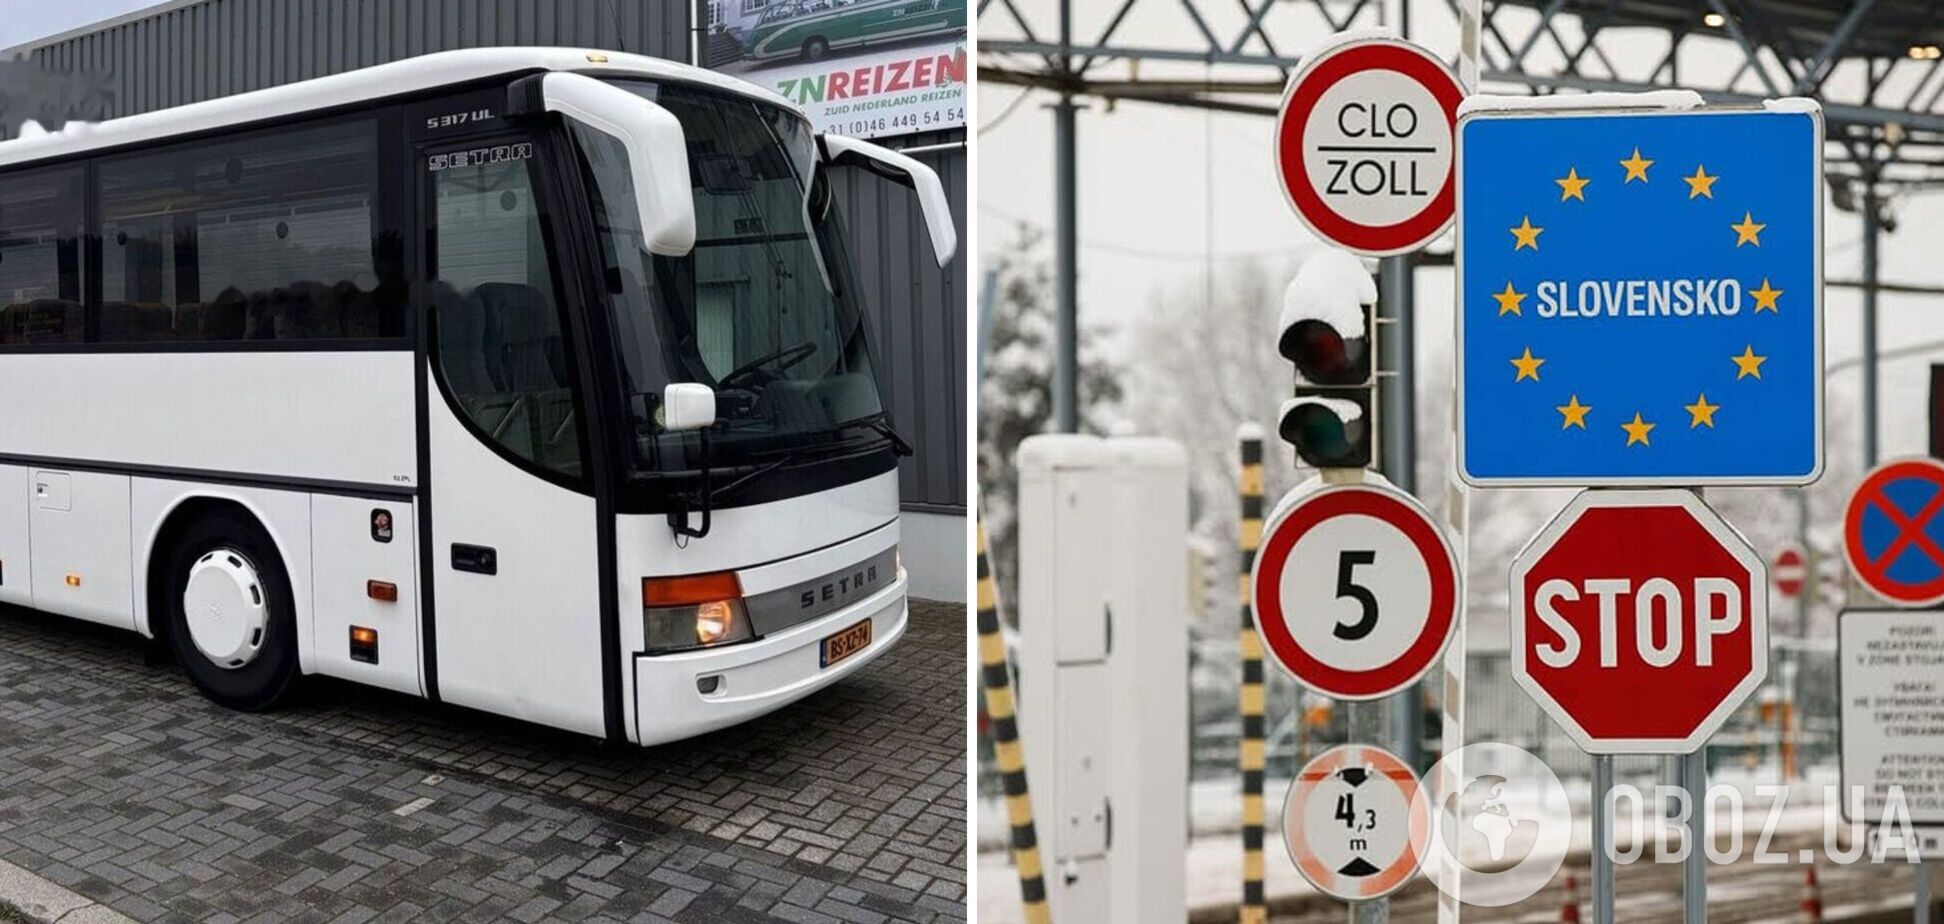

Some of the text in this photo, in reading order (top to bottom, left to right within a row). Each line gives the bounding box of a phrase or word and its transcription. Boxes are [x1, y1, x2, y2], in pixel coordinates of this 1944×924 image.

[777, 53, 966, 105] ZNREIZEN
[441, 112, 468, 127] 317
[471, 109, 495, 121] UL
[824, 89, 961, 116] ZUID NEDERLAND REIZEN
[892, 114, 917, 127] 449
[924, 111, 940, 124] 54
[948, 107, 964, 121] 54
[1338, 103, 1417, 137] CLO
[429, 143, 532, 171] SETRA
[1326, 160, 1428, 195] ZOLL
[1536, 278, 1742, 318] SLOVENSKO
[801, 566, 877, 609] SETRA
[1333, 550, 1380, 641] 5
[1534, 577, 1743, 669] STOP
[830, 624, 868, 659] BS-XZ-74
[1335, 793, 1376, 832] 4,3
[1350, 839, 1367, 851] m
